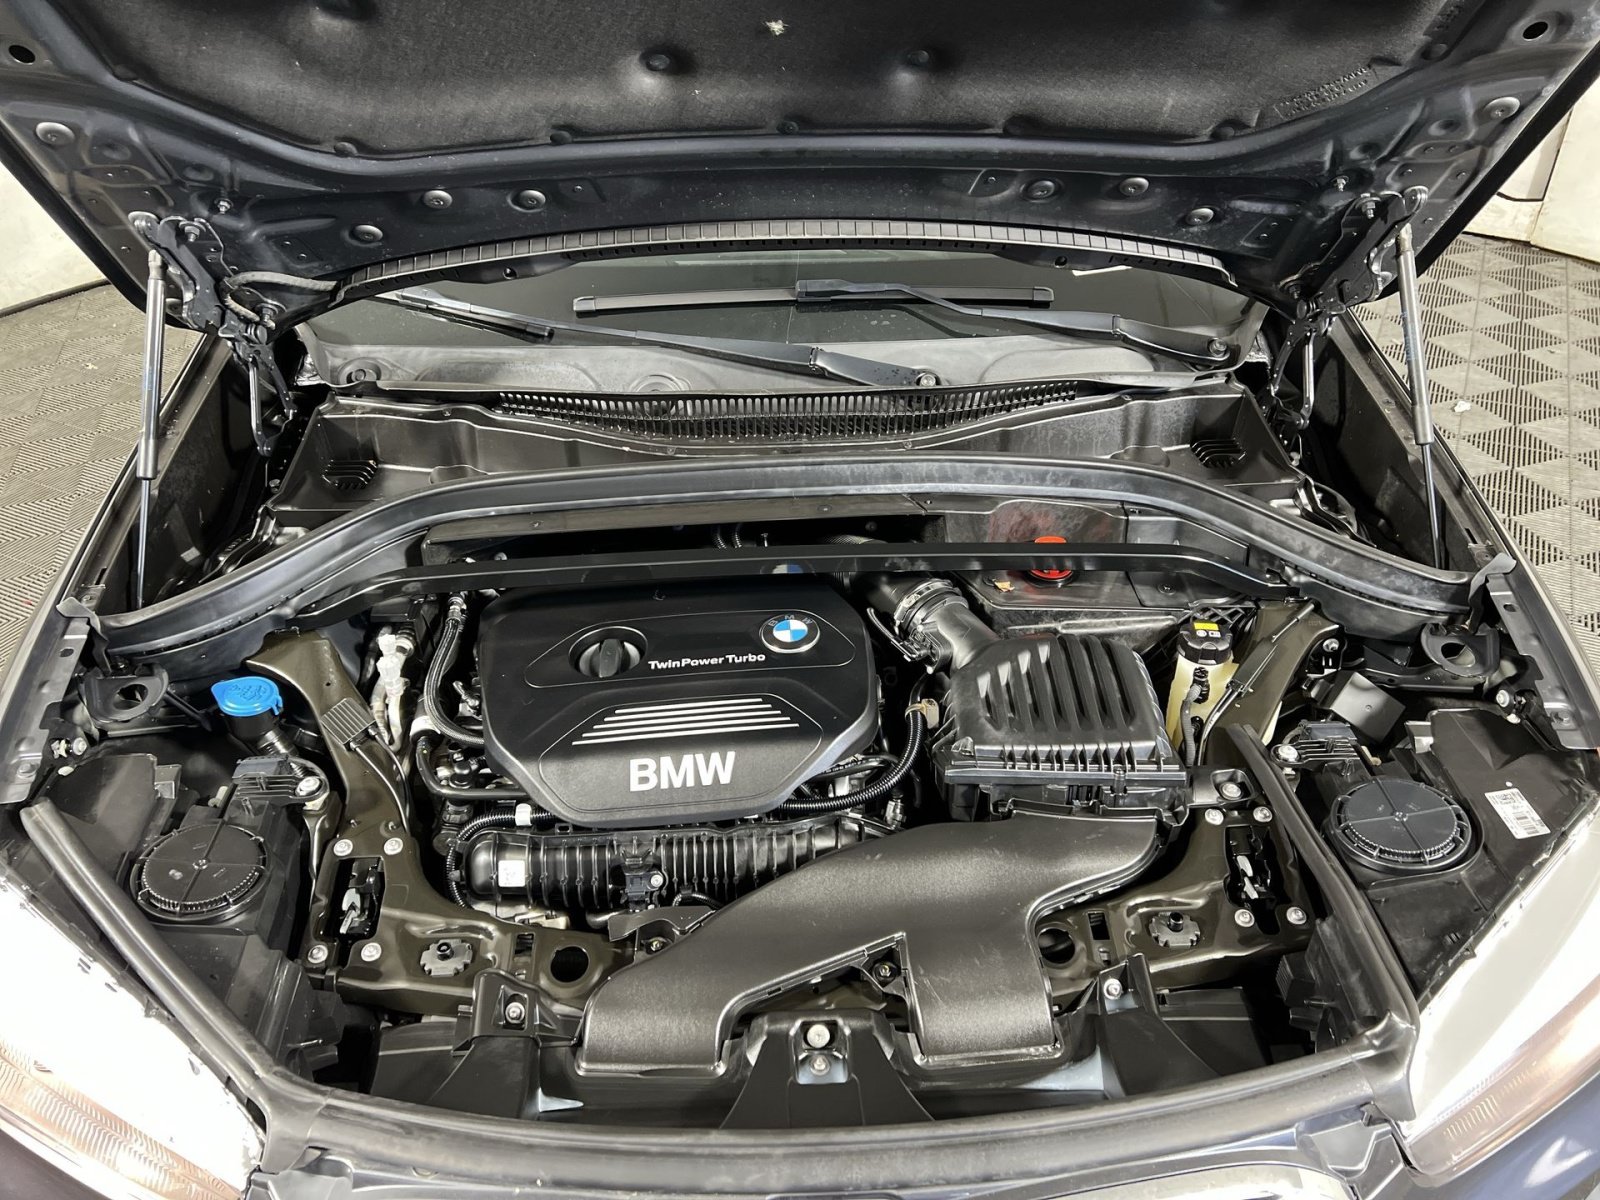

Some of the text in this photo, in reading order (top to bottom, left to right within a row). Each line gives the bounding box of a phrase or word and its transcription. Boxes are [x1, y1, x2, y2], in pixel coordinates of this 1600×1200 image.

[768, 614, 813, 627] BMW
[648, 653, 766, 670] TwinPower Turbo
[630, 751, 736, 792] BMW
